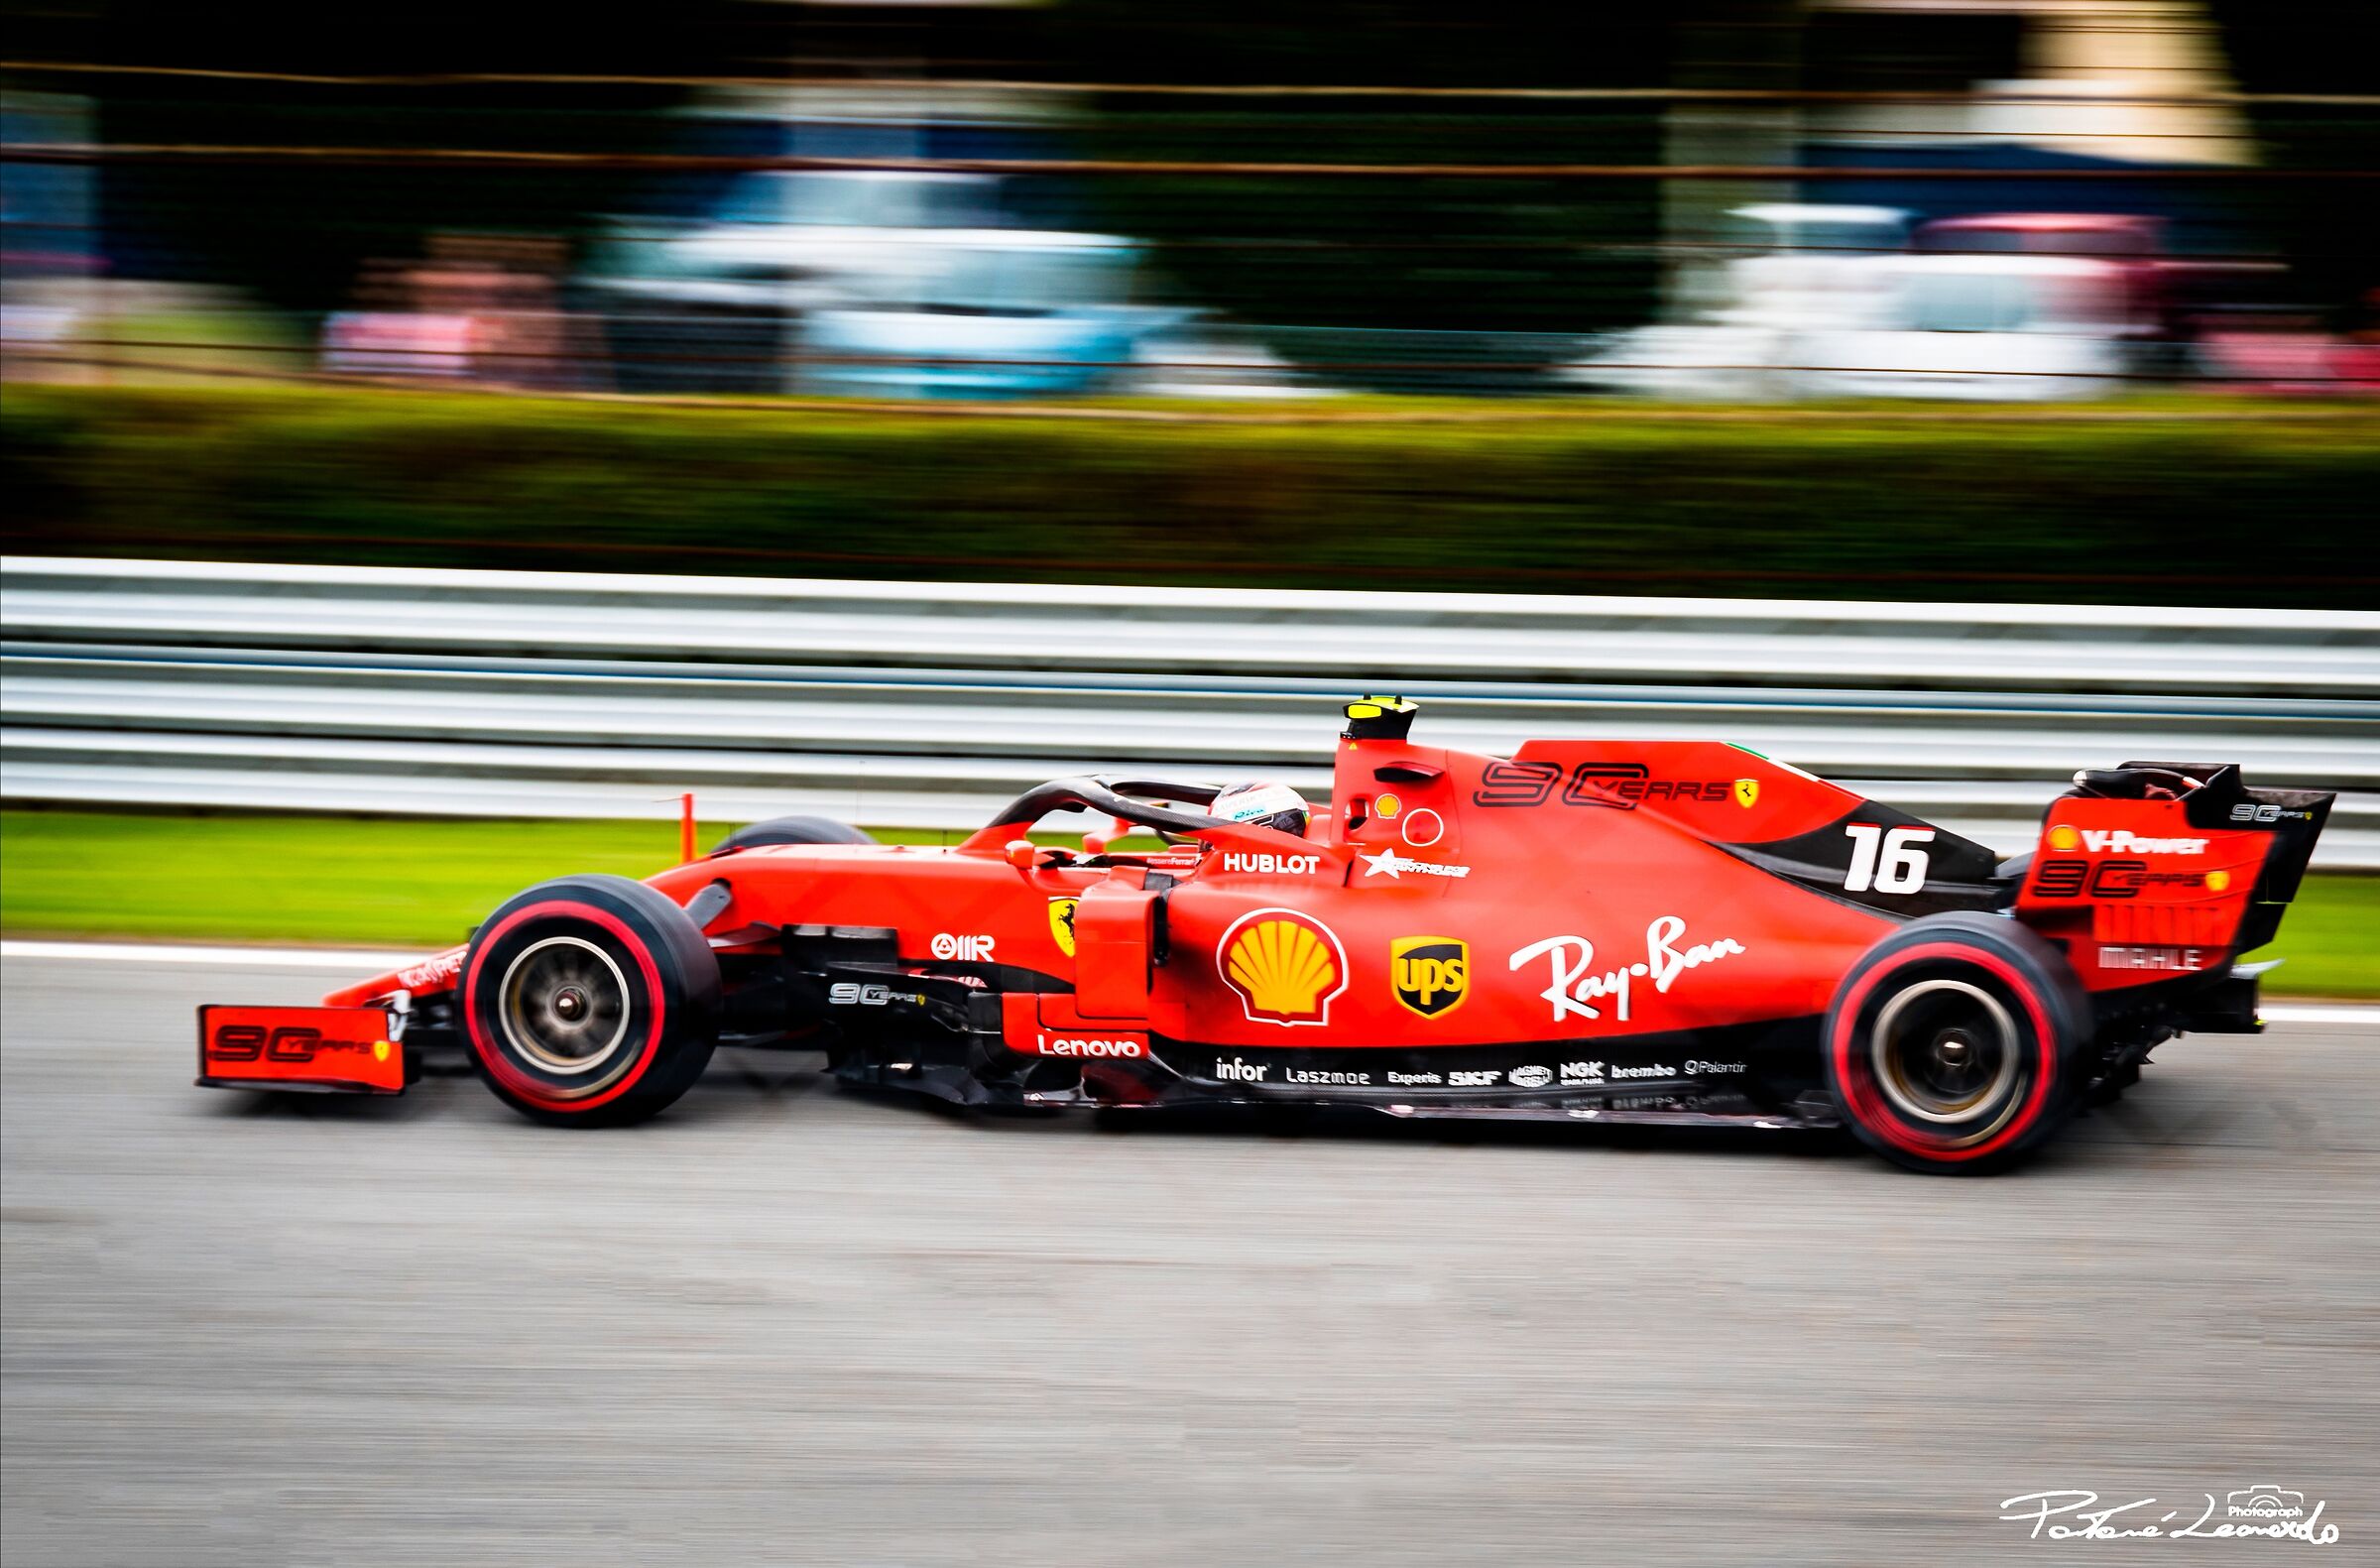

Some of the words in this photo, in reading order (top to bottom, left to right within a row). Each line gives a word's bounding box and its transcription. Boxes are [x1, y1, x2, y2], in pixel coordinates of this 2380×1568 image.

[1592, 780, 1731, 801] YEARS
[2081, 829, 2210, 854] V-Power
[1224, 853, 1320, 875] HUBLOT
[1844, 824, 1936, 894] 16
[1508, 915, 1746, 1023] Ray-Ban
[2098, 947, 2202, 971] MAHLE
[1397, 957, 1464, 1006] ups
[1037, 1033, 1141, 1059] Lenovo
[1216, 1056, 1270, 1081] infor
[1387, 1071, 1442, 1086] Experis
[1448, 1071, 1501, 1086] SKF
[1560, 1061, 1605, 1078] NGK
[1611, 1064, 1677, 1078] brembo
